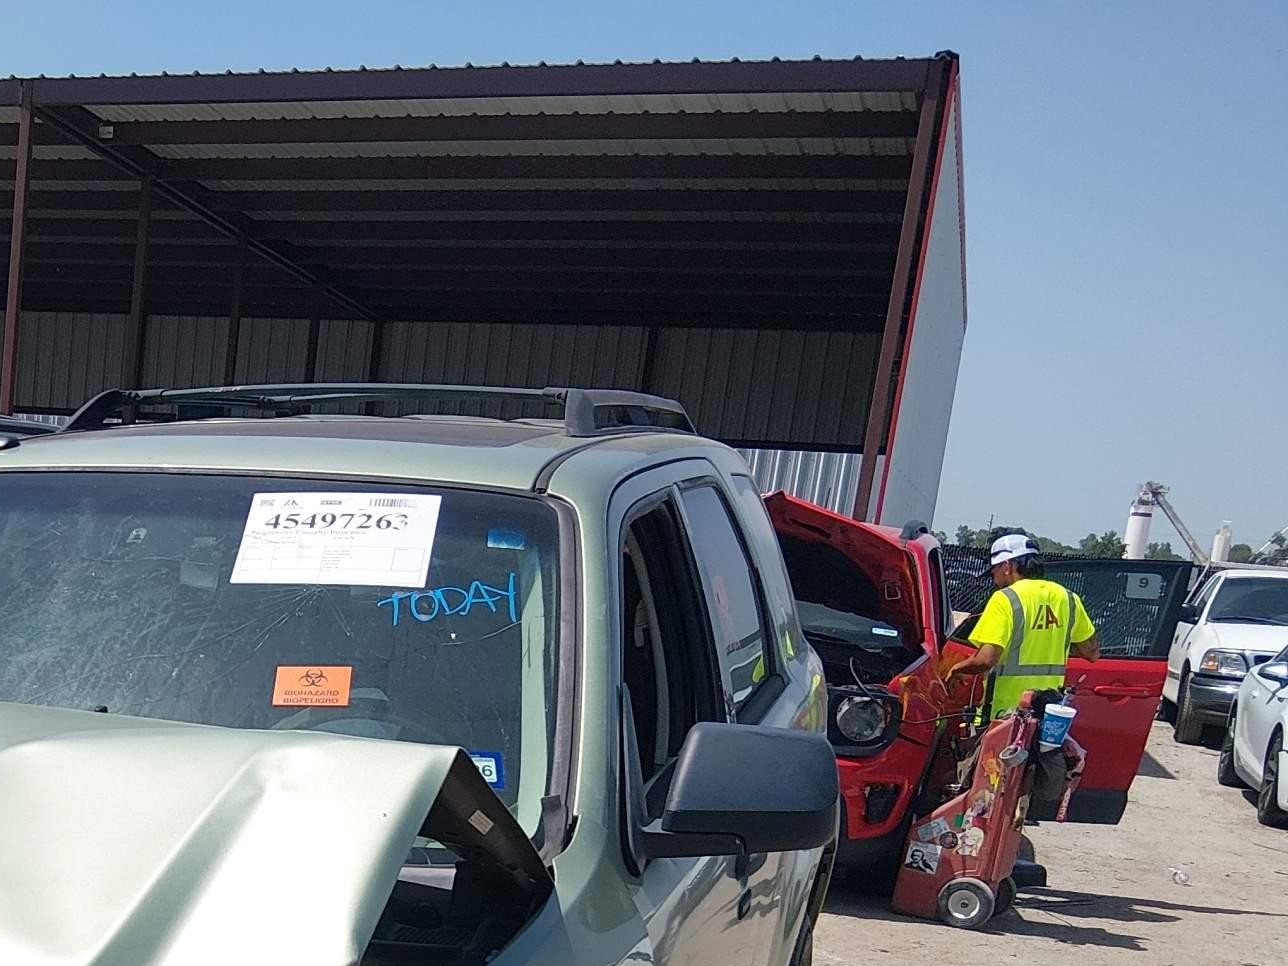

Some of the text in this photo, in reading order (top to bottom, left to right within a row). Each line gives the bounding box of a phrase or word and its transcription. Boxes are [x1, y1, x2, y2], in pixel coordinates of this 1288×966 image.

[264, 512, 410, 531] 45497263
[376, 572, 518, 626] TODAY
[477, 764, 493, 777] 6
